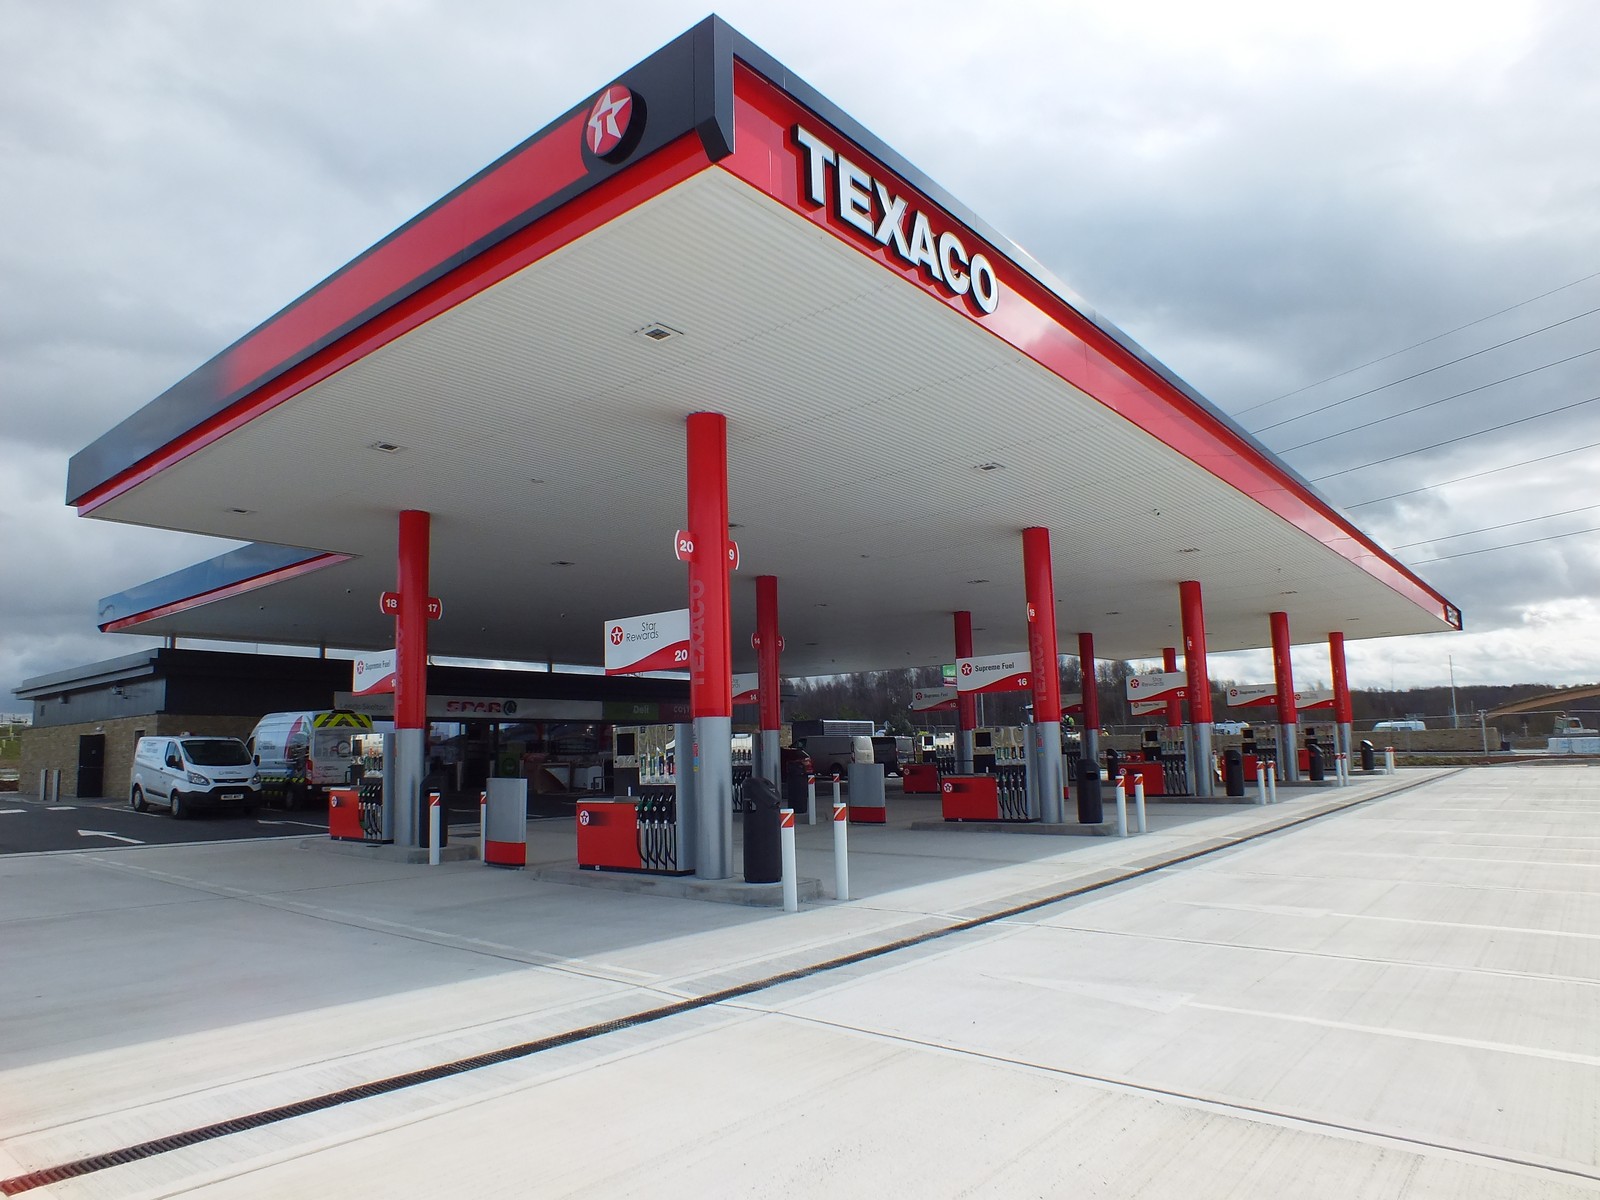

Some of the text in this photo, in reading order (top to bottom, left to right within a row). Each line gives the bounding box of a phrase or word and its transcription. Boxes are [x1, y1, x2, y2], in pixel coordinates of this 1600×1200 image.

[796, 124, 999, 315] TEXACO
[679, 539, 694, 553] 20
[728, 549, 735, 560] 9
[385, 599, 398, 608] 18
[428, 603, 438, 613] 17
[641, 621, 657, 632] Star
[690, 579, 705, 685] TEXACO
[626, 629, 659, 643] Rewards
[674, 649, 688, 662] 20
[365, 660, 391, 672] Supreme Fuel
[975, 662, 1015, 672] Supreme Fuel
[1017, 678, 1028, 686] 16
[447, 701, 501, 713] SPAR
[632, 705, 649, 714] Deli
